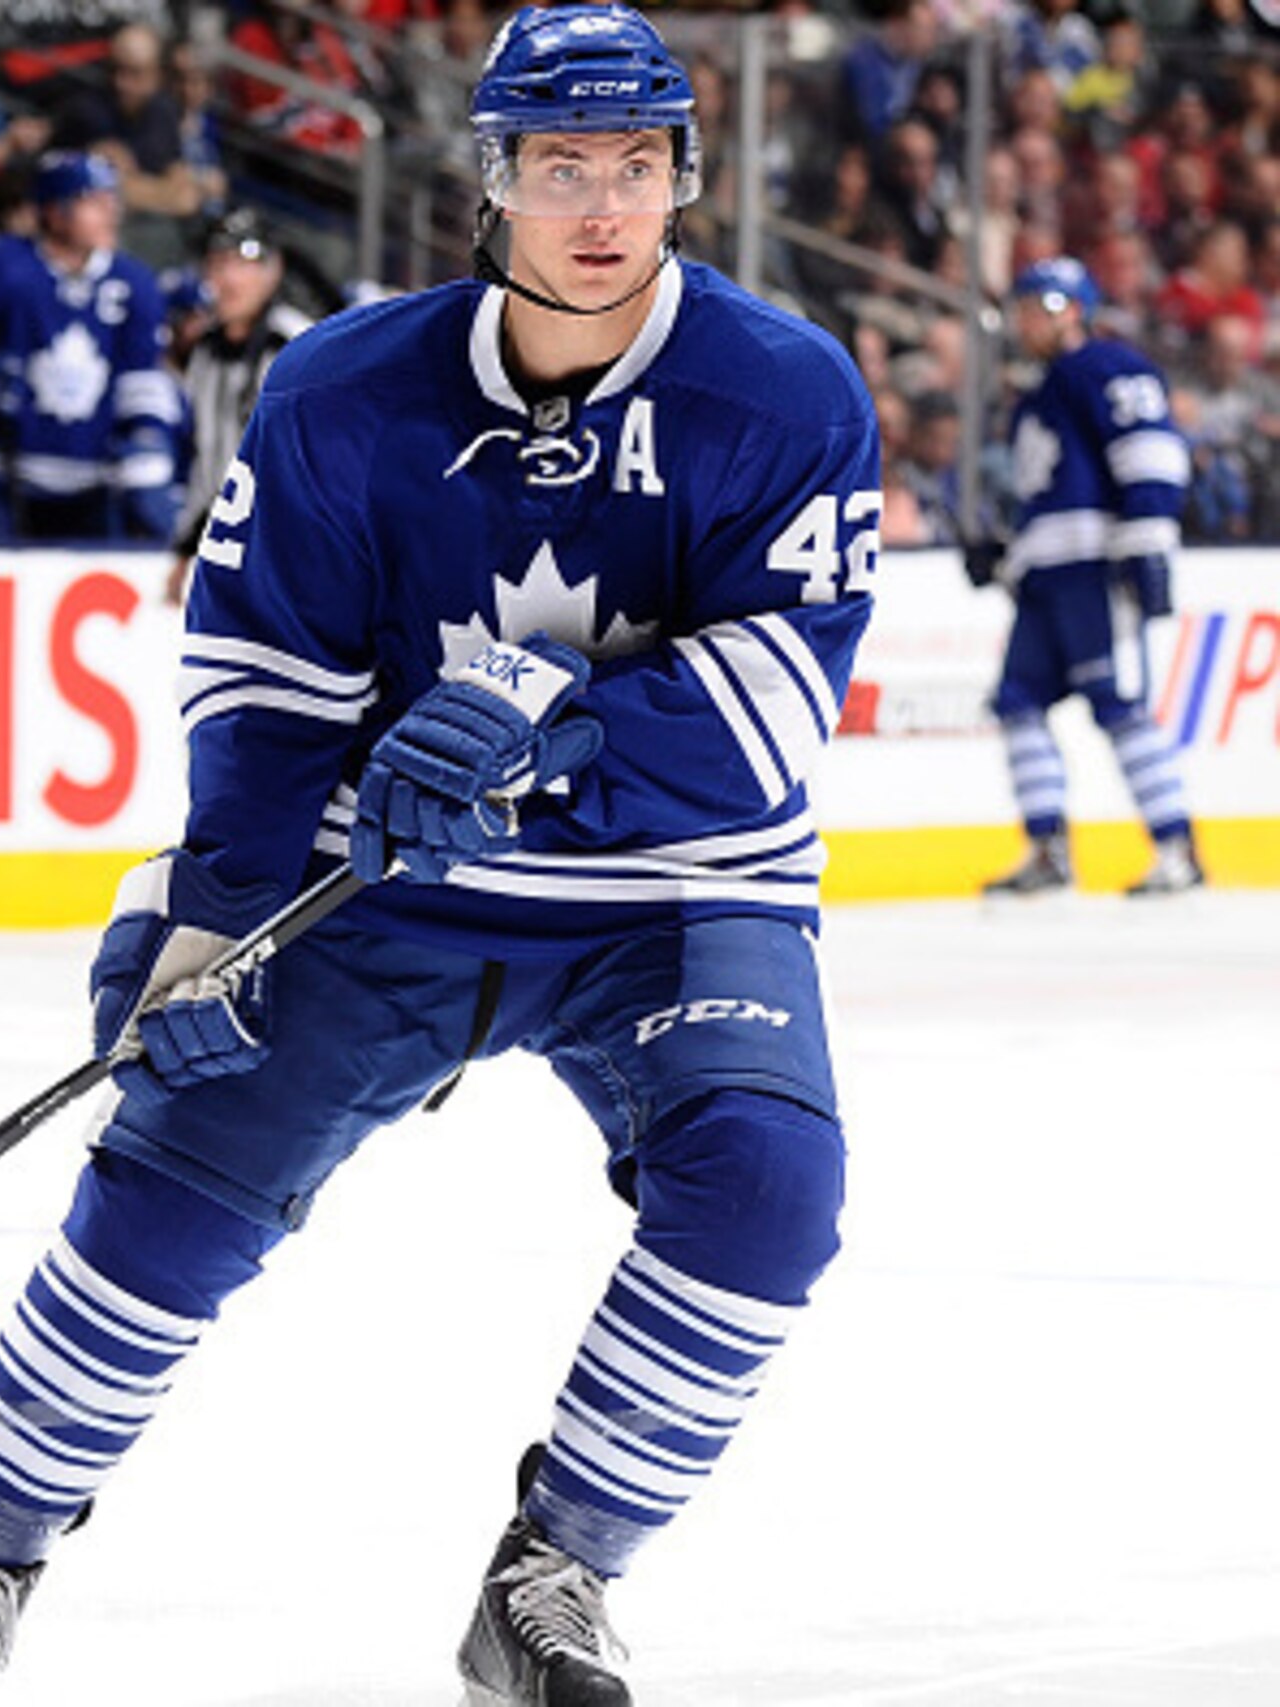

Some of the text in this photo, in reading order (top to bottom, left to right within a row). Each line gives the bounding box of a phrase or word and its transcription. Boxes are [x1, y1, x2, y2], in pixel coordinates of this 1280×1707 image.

[96, 278, 131, 325] C
[613, 396, 666, 496] A
[767, 490, 884, 604] 42
[1216, 612, 1280, 746] P
[636, 1000, 791, 1046] CCM
